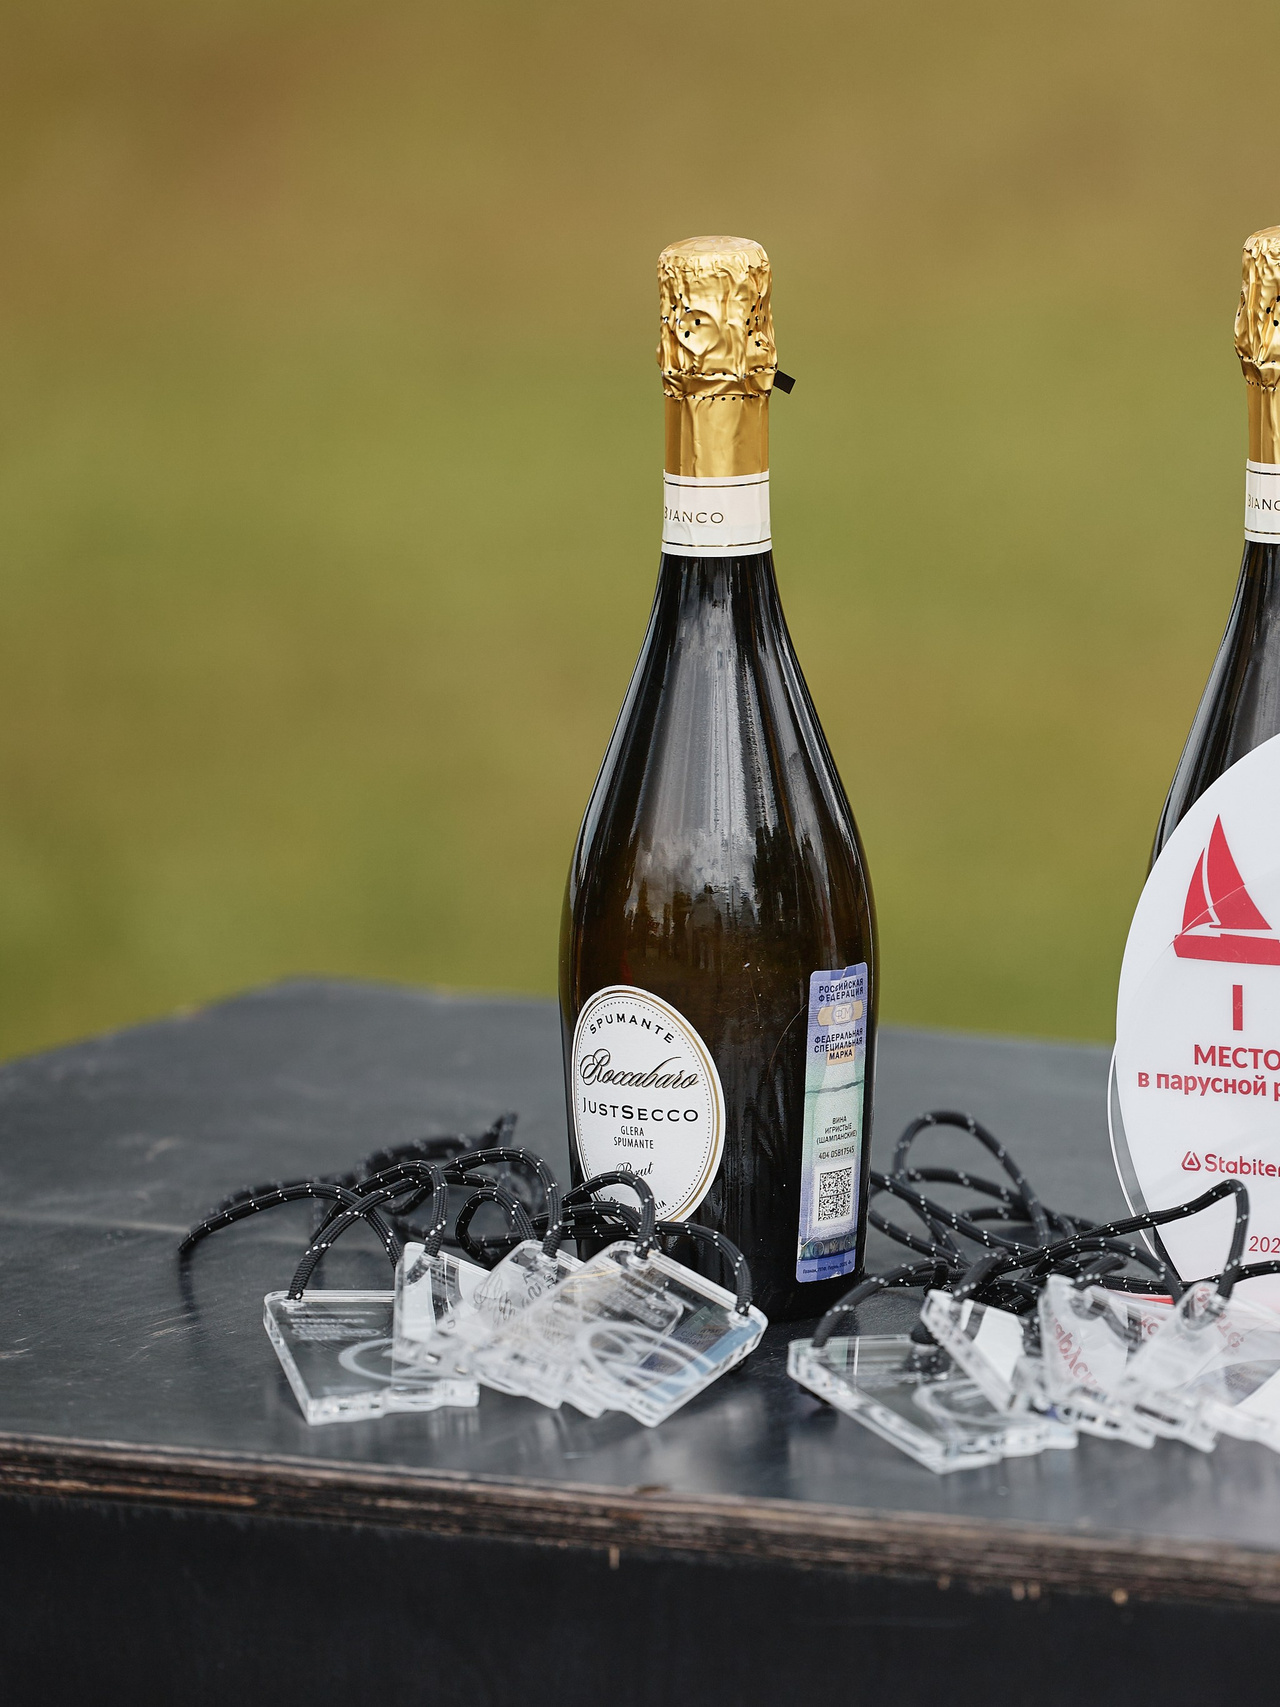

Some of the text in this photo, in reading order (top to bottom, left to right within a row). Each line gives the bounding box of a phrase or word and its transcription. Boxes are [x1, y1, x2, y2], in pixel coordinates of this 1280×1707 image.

[818, 978, 864, 994] РОССИЙСКАЯ
[818, 987, 864, 1002] ФЕДЕРАЦИЯ
[590, 1013, 675, 1044] SPUMANTE
[814, 1028, 863, 1044] ФЕДЕРАЛЬНАЯ
[814, 1037, 863, 1053] СПЕЦИАЛЬНАЯ
[829, 1049, 853, 1060] МАРКА
[580, 1048, 699, 1089] Roccabaro
[1137, 1072, 1150, 1088] в
[1156, 1073, 1267, 1097] парусной
[582, 1097, 698, 1122] JUSTSECCO
[620, 1126, 644, 1136] GLERA
[614, 1136, 654, 1150] SPUMANTE
